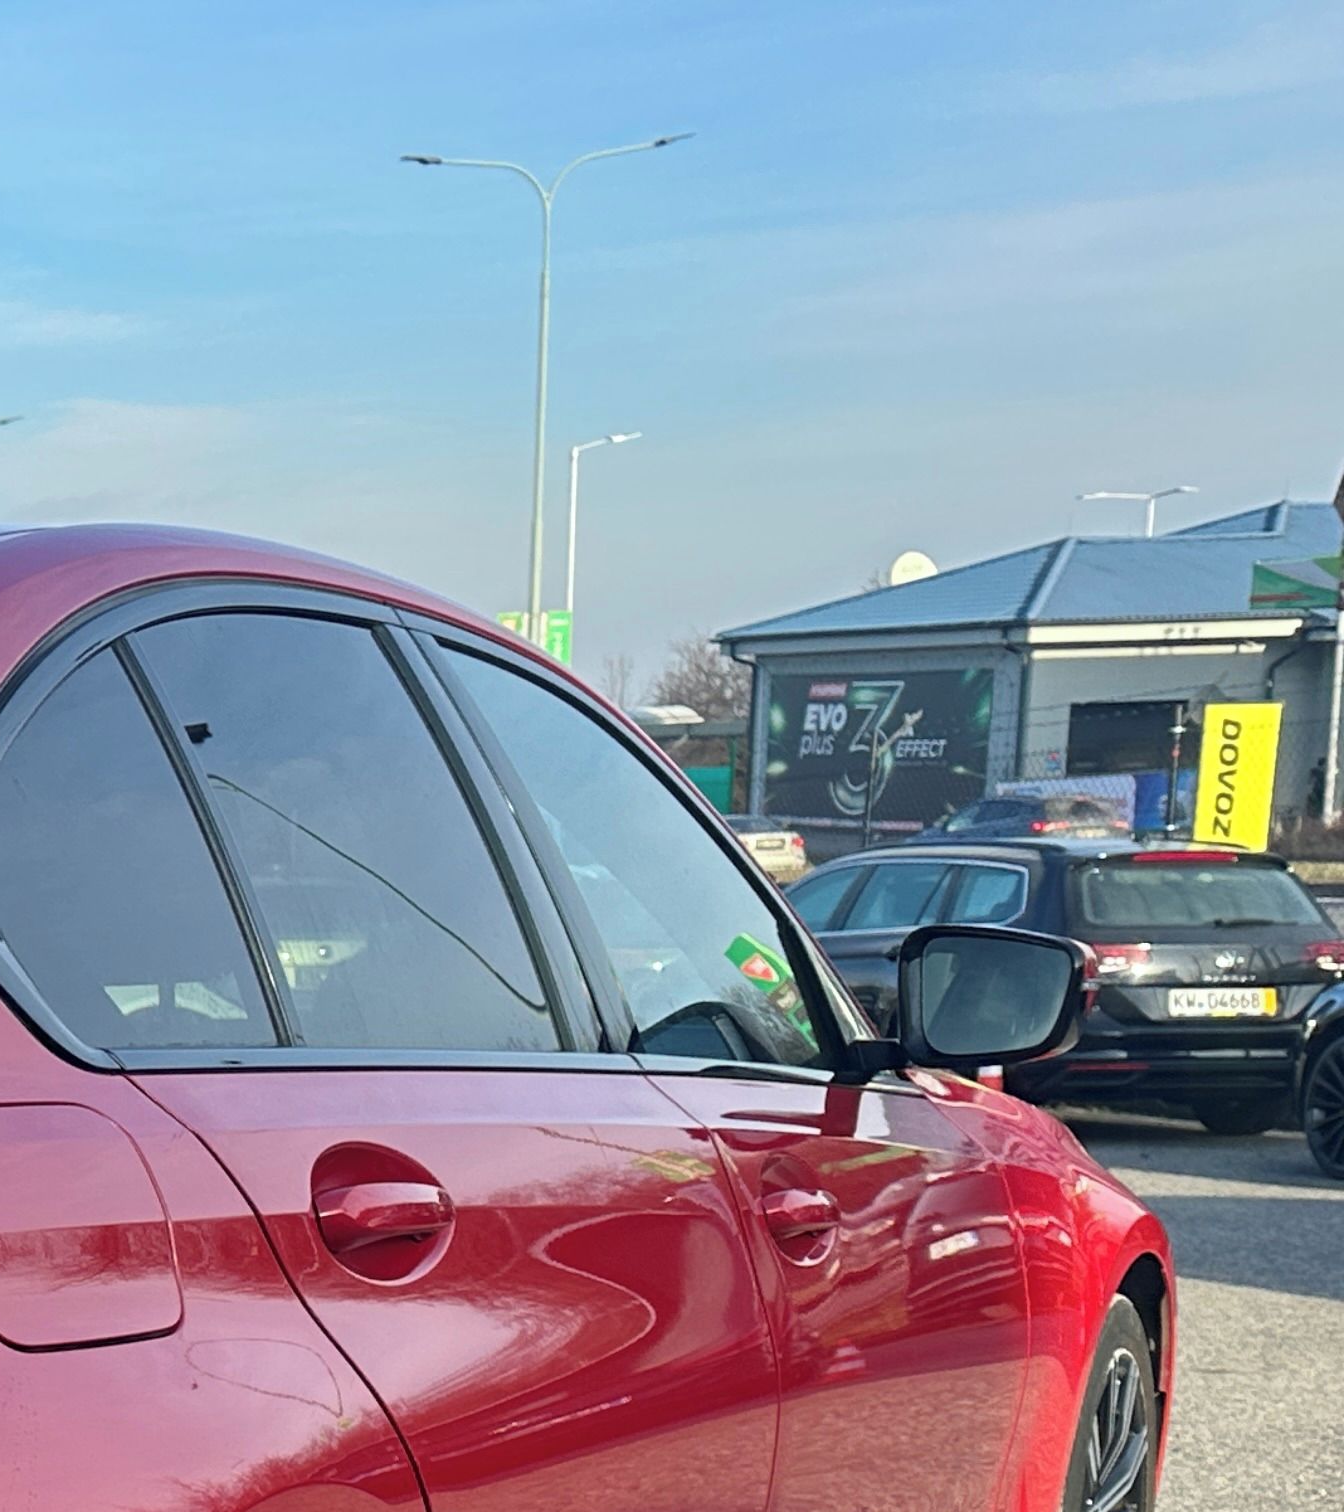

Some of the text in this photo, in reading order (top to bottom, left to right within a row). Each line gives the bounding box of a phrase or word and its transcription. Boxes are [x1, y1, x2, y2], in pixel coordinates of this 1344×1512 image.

[803, 703, 848, 732] EVO
[799, 731, 835, 760] plus
[895, 739, 948, 759] EFFECT
[1212, 718, 1242, 838] DOVOZ
